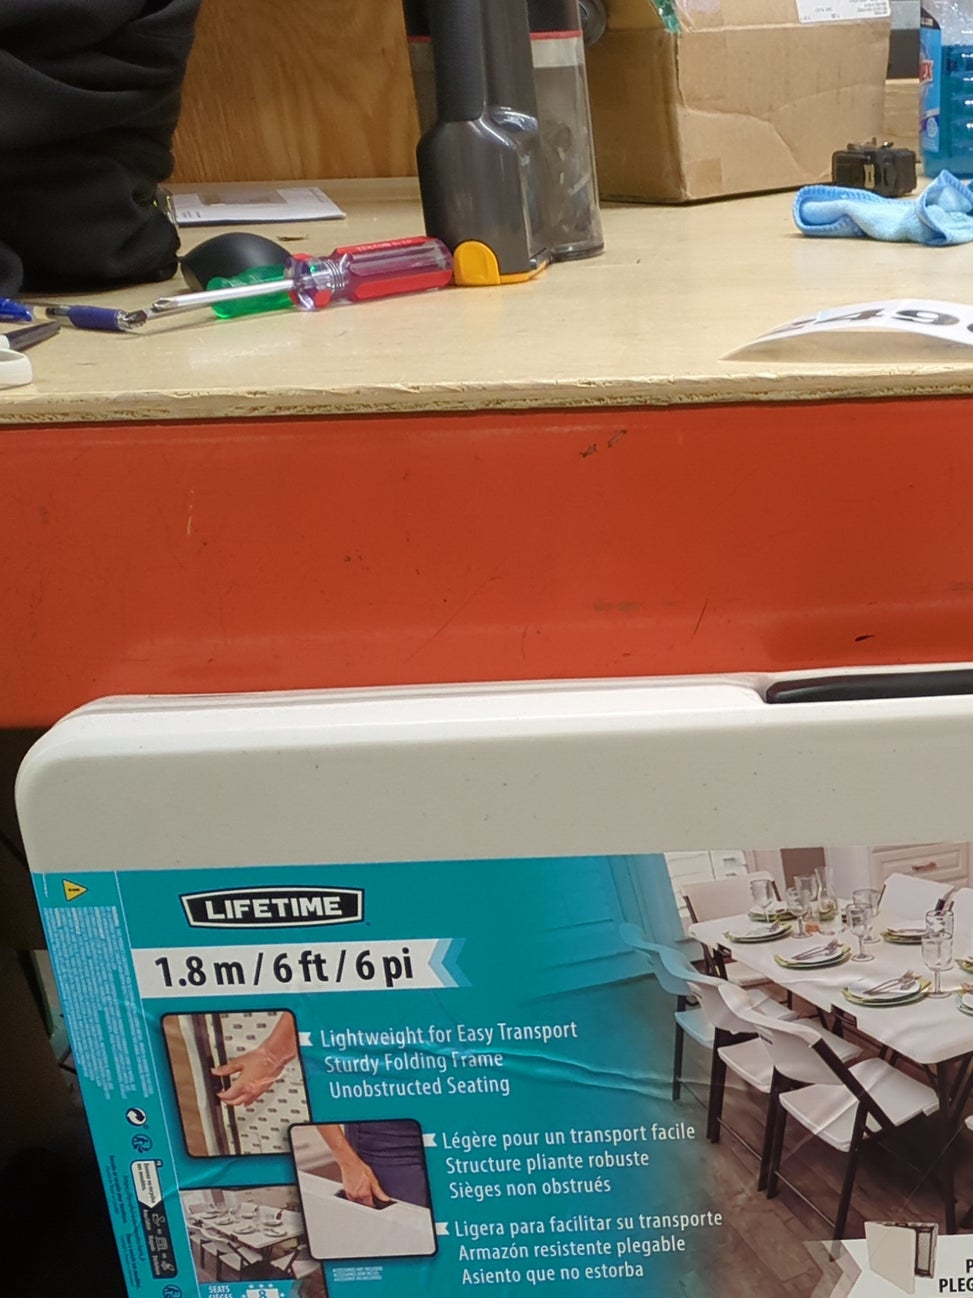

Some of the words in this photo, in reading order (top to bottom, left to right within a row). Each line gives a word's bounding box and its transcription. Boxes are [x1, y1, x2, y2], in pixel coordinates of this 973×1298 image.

[205, 896, 342, 920] LIFETIME
[154, 955, 207, 988] 1.8
[214, 960, 245, 986] m
[273, 953, 293, 983] 6
[298, 950, 328, 983] ft
[355, 950, 375, 981] 6
[382, 947, 413, 988] pi
[320, 1027, 425, 1051] Lightweight
[428, 1025, 451, 1044] for
[457, 1024, 493, 1045] Easy
[497, 1021, 578, 1043] Transport
[324, 1055, 379, 1075] Sturdy
[384, 1052, 446, 1073] Folding
[451, 1051, 504, 1069] Frame
[329, 1077, 443, 1099] Unobstructed
[447, 1076, 510, 1097] Seating
[442, 1131, 497, 1152] Légère
[502, 1131, 539, 1150] pour
[545, 1130, 565, 1145] un
[570, 1125, 647, 1145] transport
[650, 1122, 696, 1141] facile
[446, 1156, 521, 1174] Structure
[526, 1154, 584, 1174] pliante
[588, 1150, 649, 1168] robuste
[449, 1181, 501, 1202] Sièges
[506, 1182, 537, 1197] non
[542, 1175, 611, 1195] obstrués
[454, 1220, 504, 1240] Ligera
[510, 1219, 545, 1238] para
[549, 1214, 612, 1233] facilitar
[616, 1215, 634, 1230] su
[639, 1210, 723, 1231] transporte
[458, 1243, 529, 1261] Armazón
[534, 1240, 612, 1259] resistente
[616, 1235, 685, 1257] plegable
[462, 1267, 521, 1285] Asiento
[526, 1266, 556, 1284] que
[560, 1265, 580, 1280] no
[585, 1261, 644, 1280] estorba
[209, 1285, 230, 1293] SEATS
